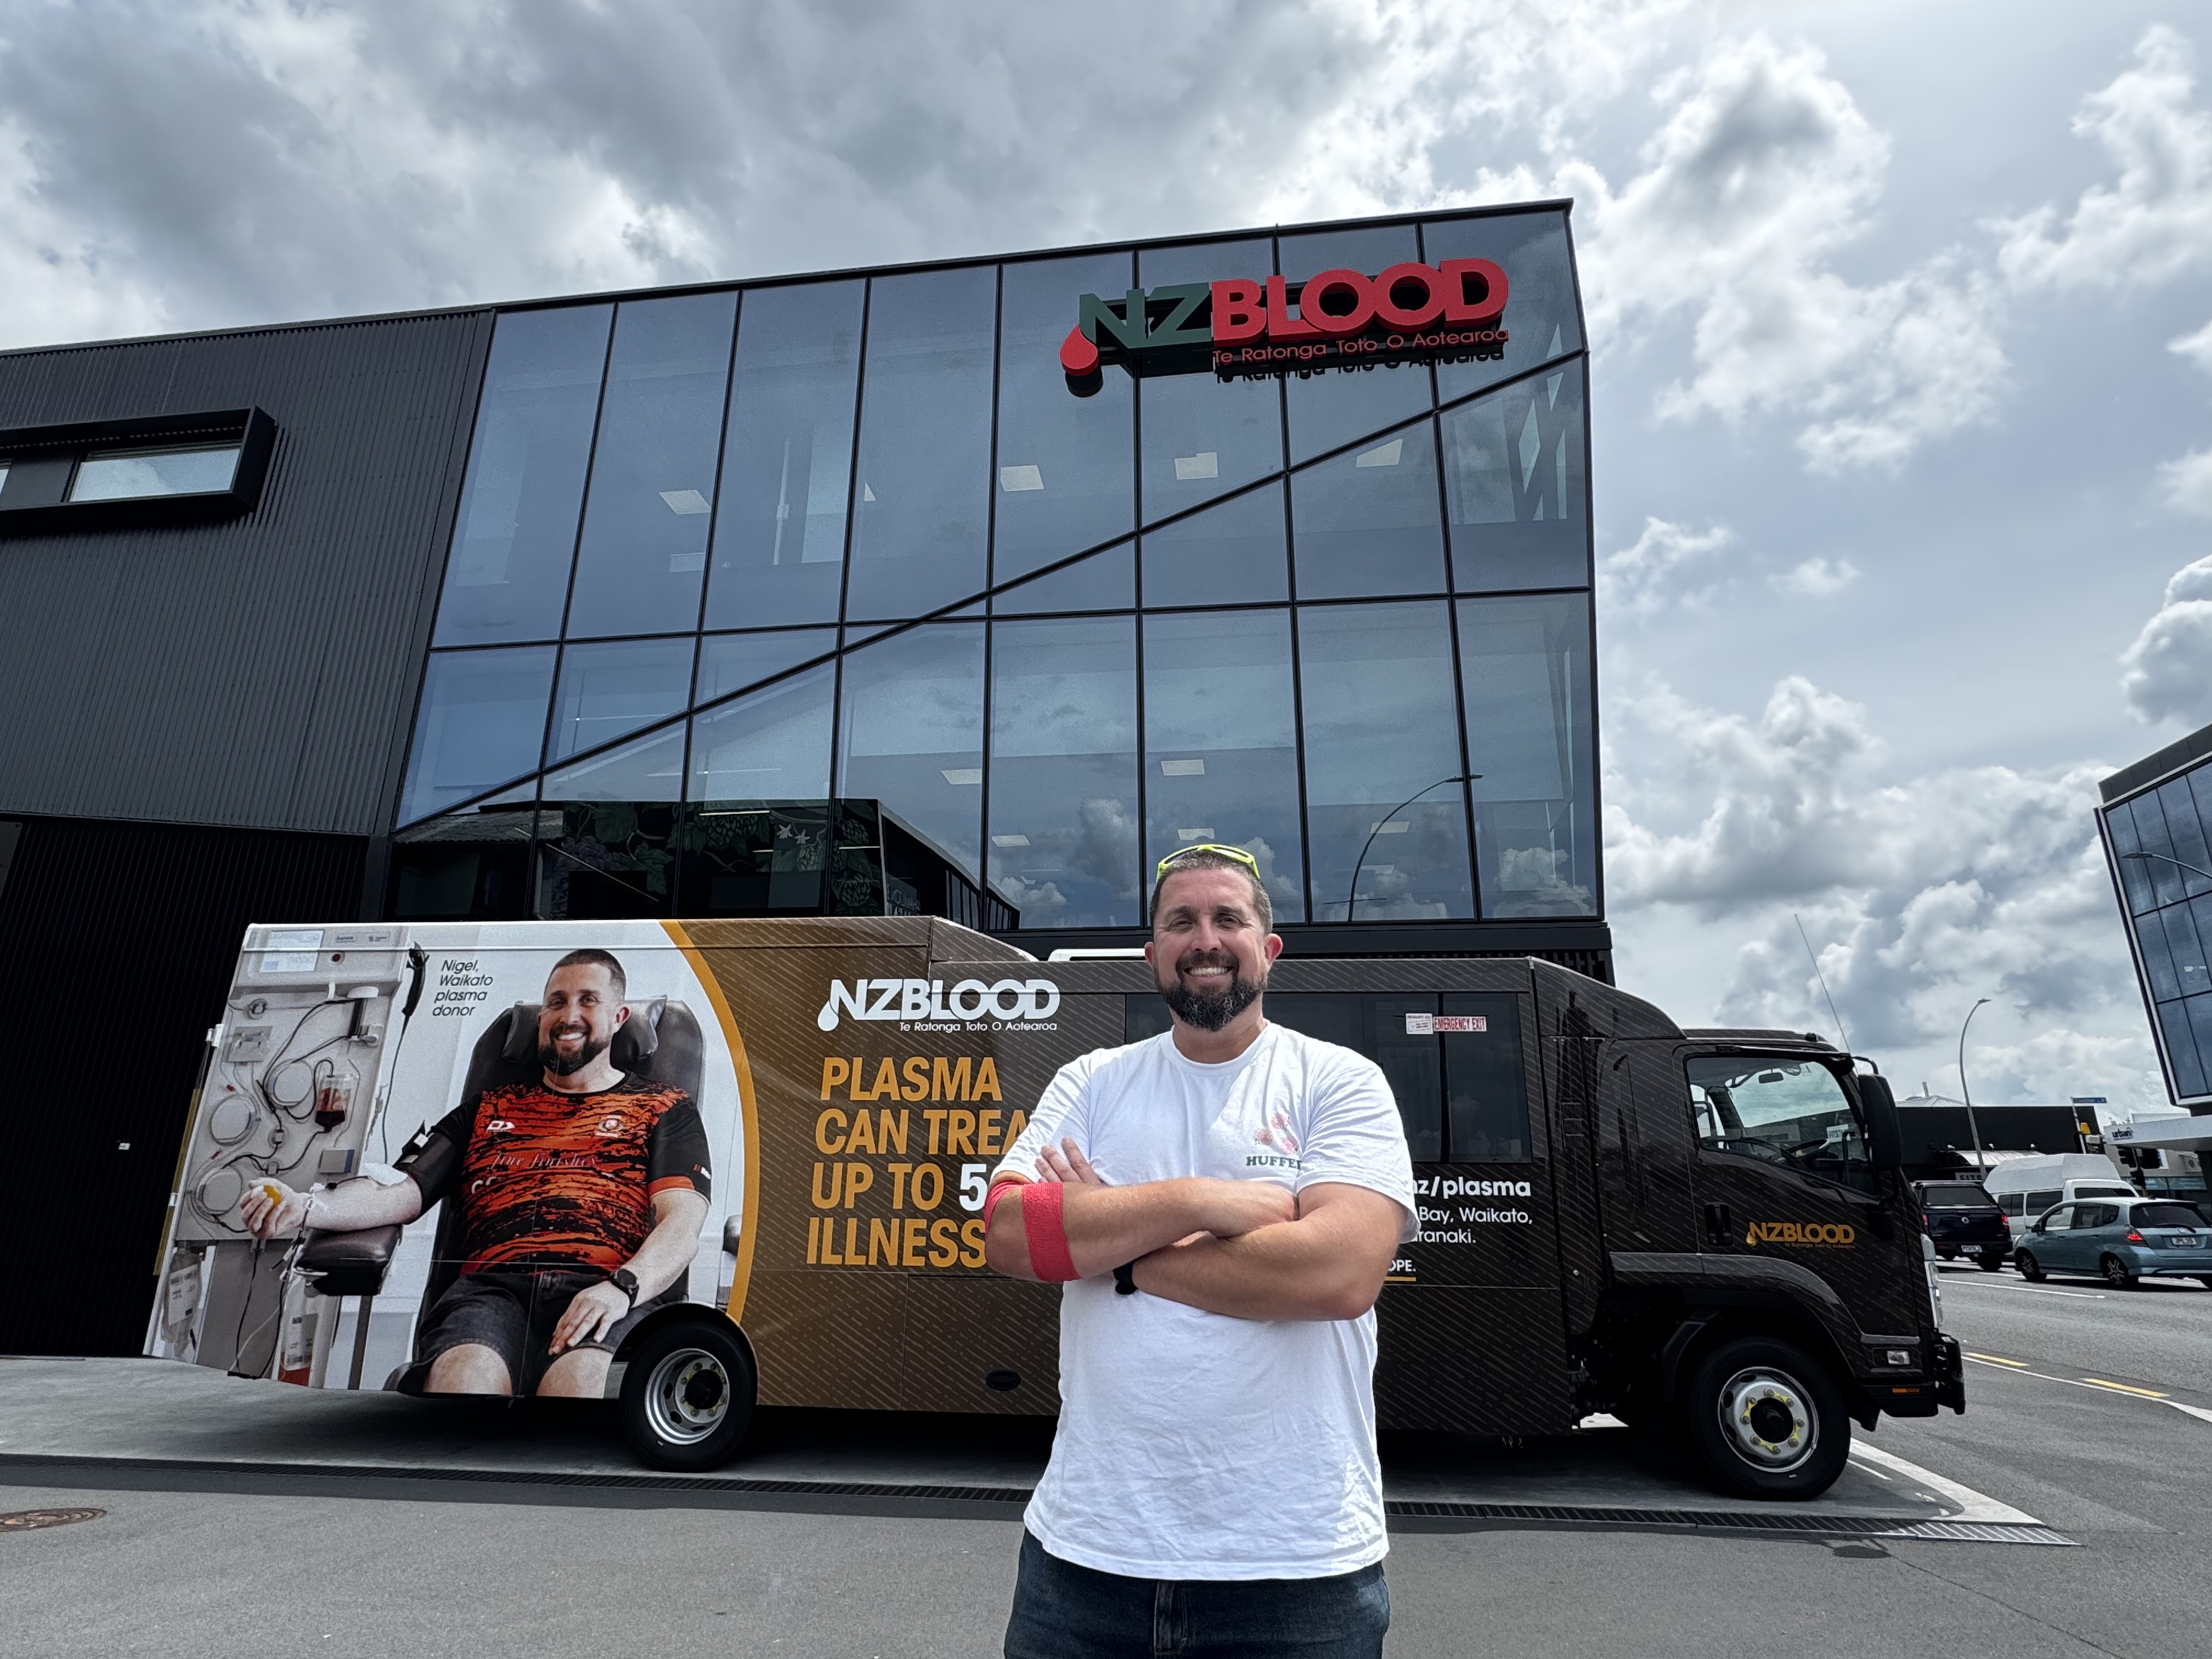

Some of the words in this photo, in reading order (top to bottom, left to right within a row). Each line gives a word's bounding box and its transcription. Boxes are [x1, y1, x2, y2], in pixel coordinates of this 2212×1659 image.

[1079, 258, 1509, 349] NZBLOOD
[1212, 350, 1233, 365] Te
[1242, 343, 1327, 361] Ratonga
[1336, 337, 1378, 354] Toto
[1386, 335, 1404, 350] O
[1412, 329, 1509, 348] Aotearoa
[441, 960, 479, 974] Nigel,
[439, 974, 493, 986] Waikato
[434, 989, 488, 1003] plasma
[830, 979, 1060, 1020] NZBLOOD
[432, 1005, 476, 1016] donor
[900, 1022, 910, 1031] Te
[915, 1022, 961, 1032] Ratonga
[966, 1022, 988, 1031] Toto
[992, 1022, 1002, 1031] O
[1006, 1022, 1057, 1031] Aotearoa
[1434, 1018, 1470, 1030] EMERGENCY
[1471, 1018, 1485, 1030] EXIT
[821, 1057, 1003, 1101] PLASMA
[815, 1108, 909, 1155] CAN
[811, 1162, 874, 1209] UP
[888, 1163, 945, 1210] TO
[959, 1164, 987, 1211] 5
[1419, 1206, 1454, 1224] Bay,
[1459, 1207, 1532, 1224] Waikato,
[806, 1217, 986, 1268] ILLNESS
[1749, 1221, 1855, 1243] NZBLOOD
